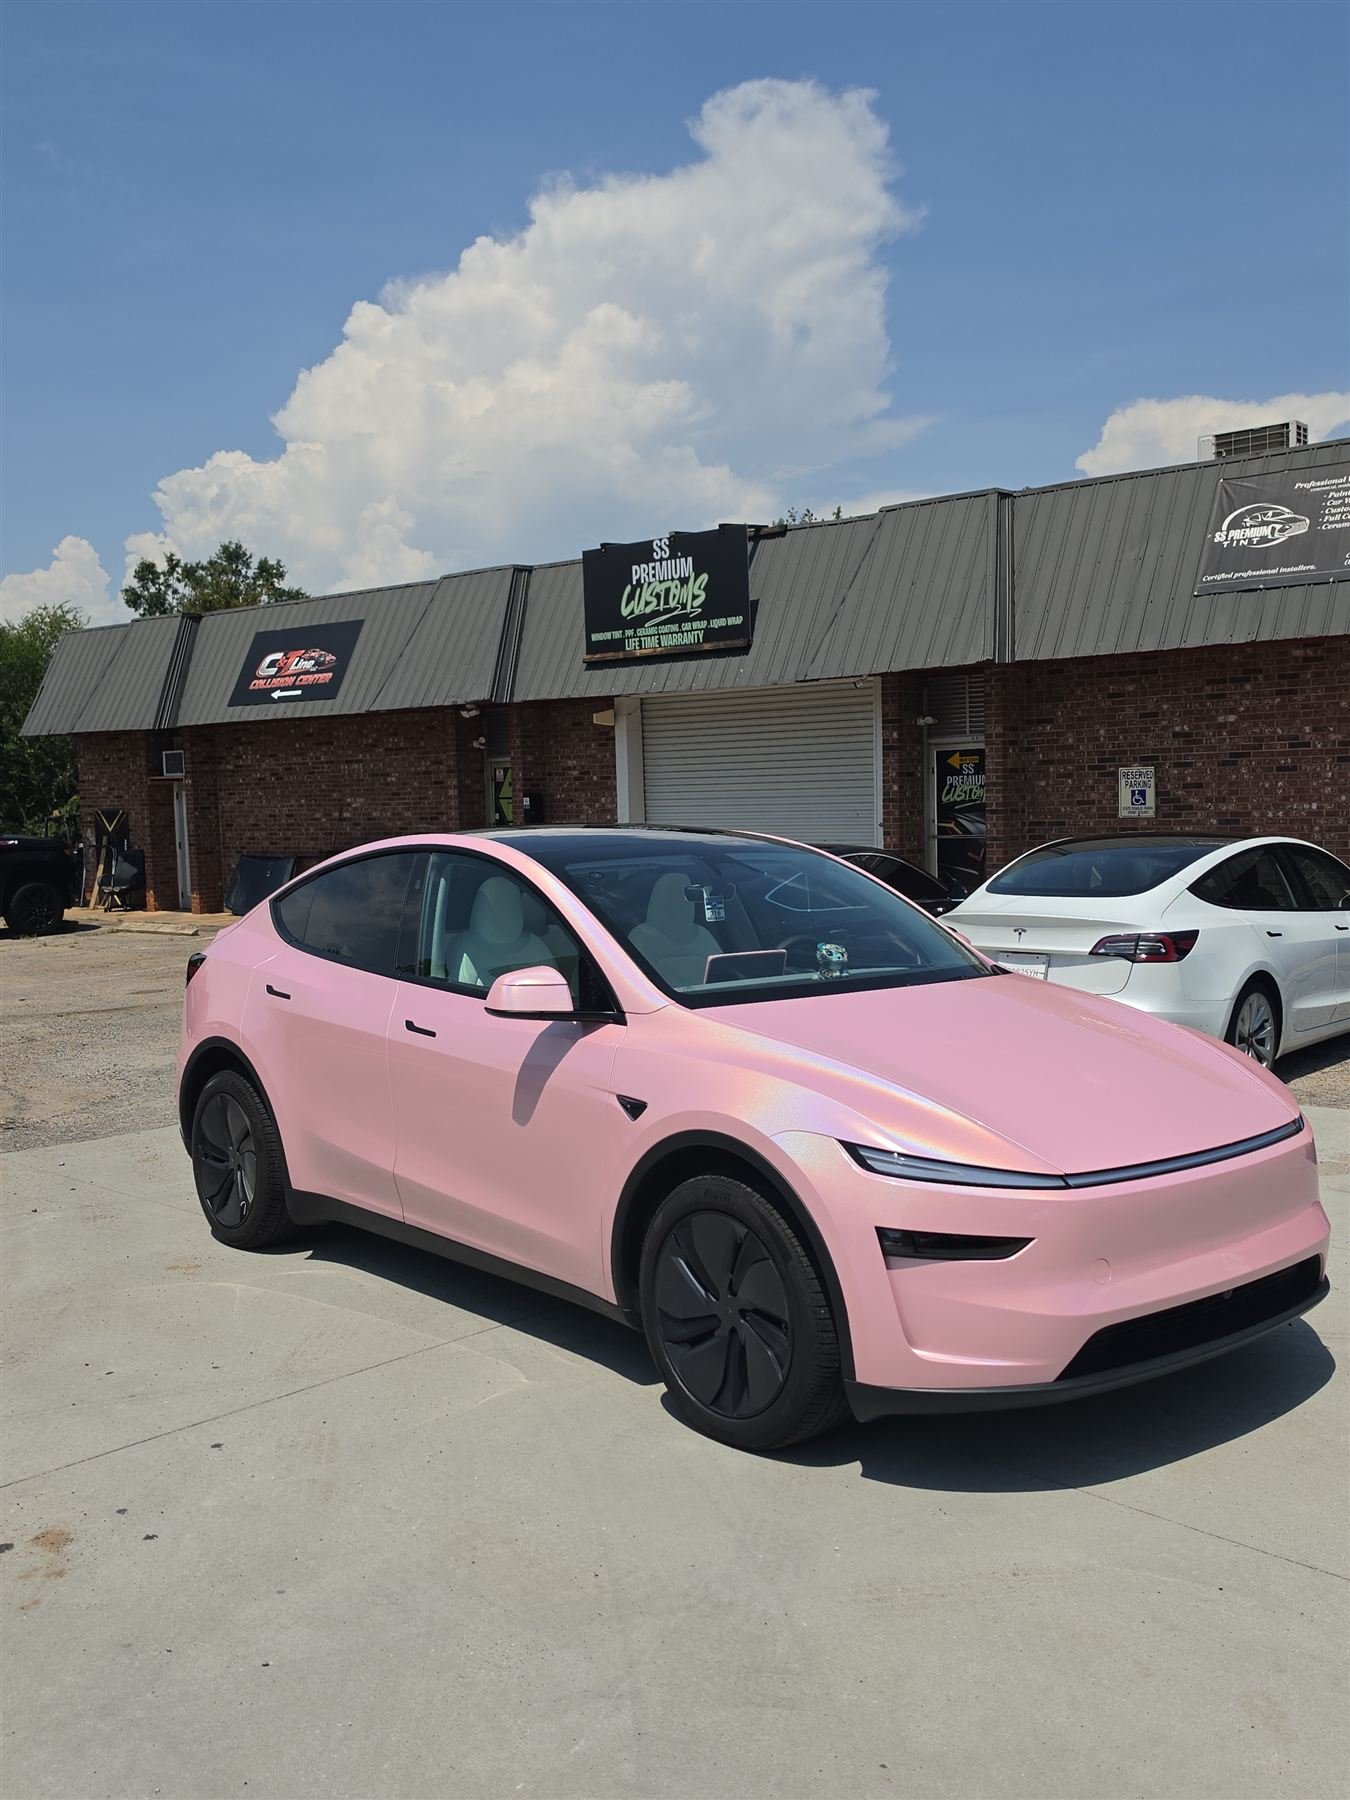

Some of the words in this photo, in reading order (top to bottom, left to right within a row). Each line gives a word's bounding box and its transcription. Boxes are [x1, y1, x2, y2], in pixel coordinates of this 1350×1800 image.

[1294, 476, 1347, 489] Professional
[1323, 514, 1341, 522] Full
[1214, 531, 1226, 542] SS
[1227, 525, 1271, 540] PREMIUM
[653, 538, 669, 559] SS
[1222, 538, 1260, 548] TINT
[632, 556, 693, 584] PREMIUM
[1202, 572, 1233, 582] Certified
[1233, 567, 1278, 579] professional
[591, 632, 612, 642] WINDOW
[612, 630, 623, 639] TINT
[636, 626, 658, 637] CERAMIC
[658, 624, 679, 634] COATING
[681, 621, 692, 632] CAR
[692, 620, 708, 630] WRAP
[710, 617, 727, 629] LIQUID
[727, 615, 744, 626] WRAP
[625, 638, 640, 651] LIFE
[641, 635, 659, 649] TIME
[660, 629, 704, 647] WARRANTY
[249, 677, 296, 689] COLLISION
[296, 673, 333, 685] CENTER
[962, 763, 975, 774] SS
[1121, 771, 1153, 780] RESERVED
[1125, 780, 1152, 789] PARKING
